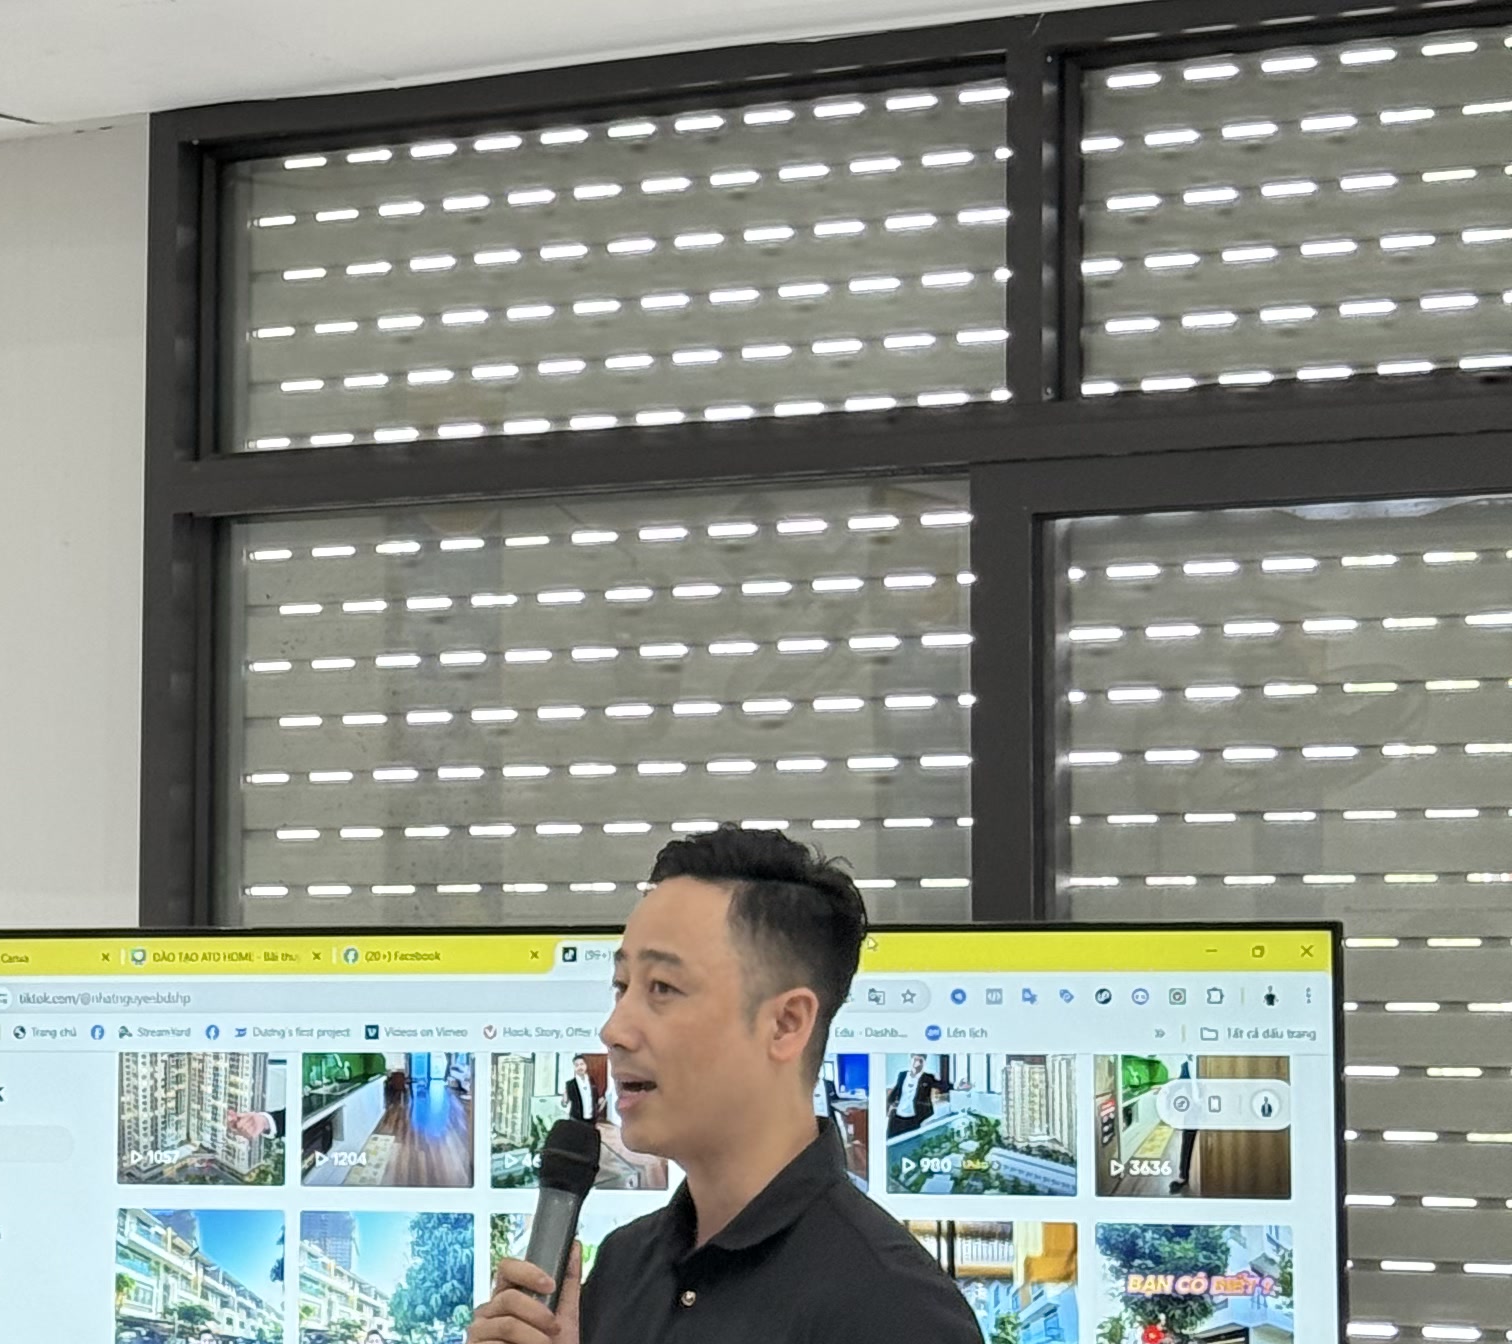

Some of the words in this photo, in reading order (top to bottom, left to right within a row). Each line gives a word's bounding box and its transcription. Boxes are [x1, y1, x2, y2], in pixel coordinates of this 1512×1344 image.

[31, 1026, 58, 1039] Trang
[1129, 1159, 1173, 1176] 3636
[1126, 1273, 1175, 1297] BẠN
[1175, 1271, 1209, 1296] CÓ
